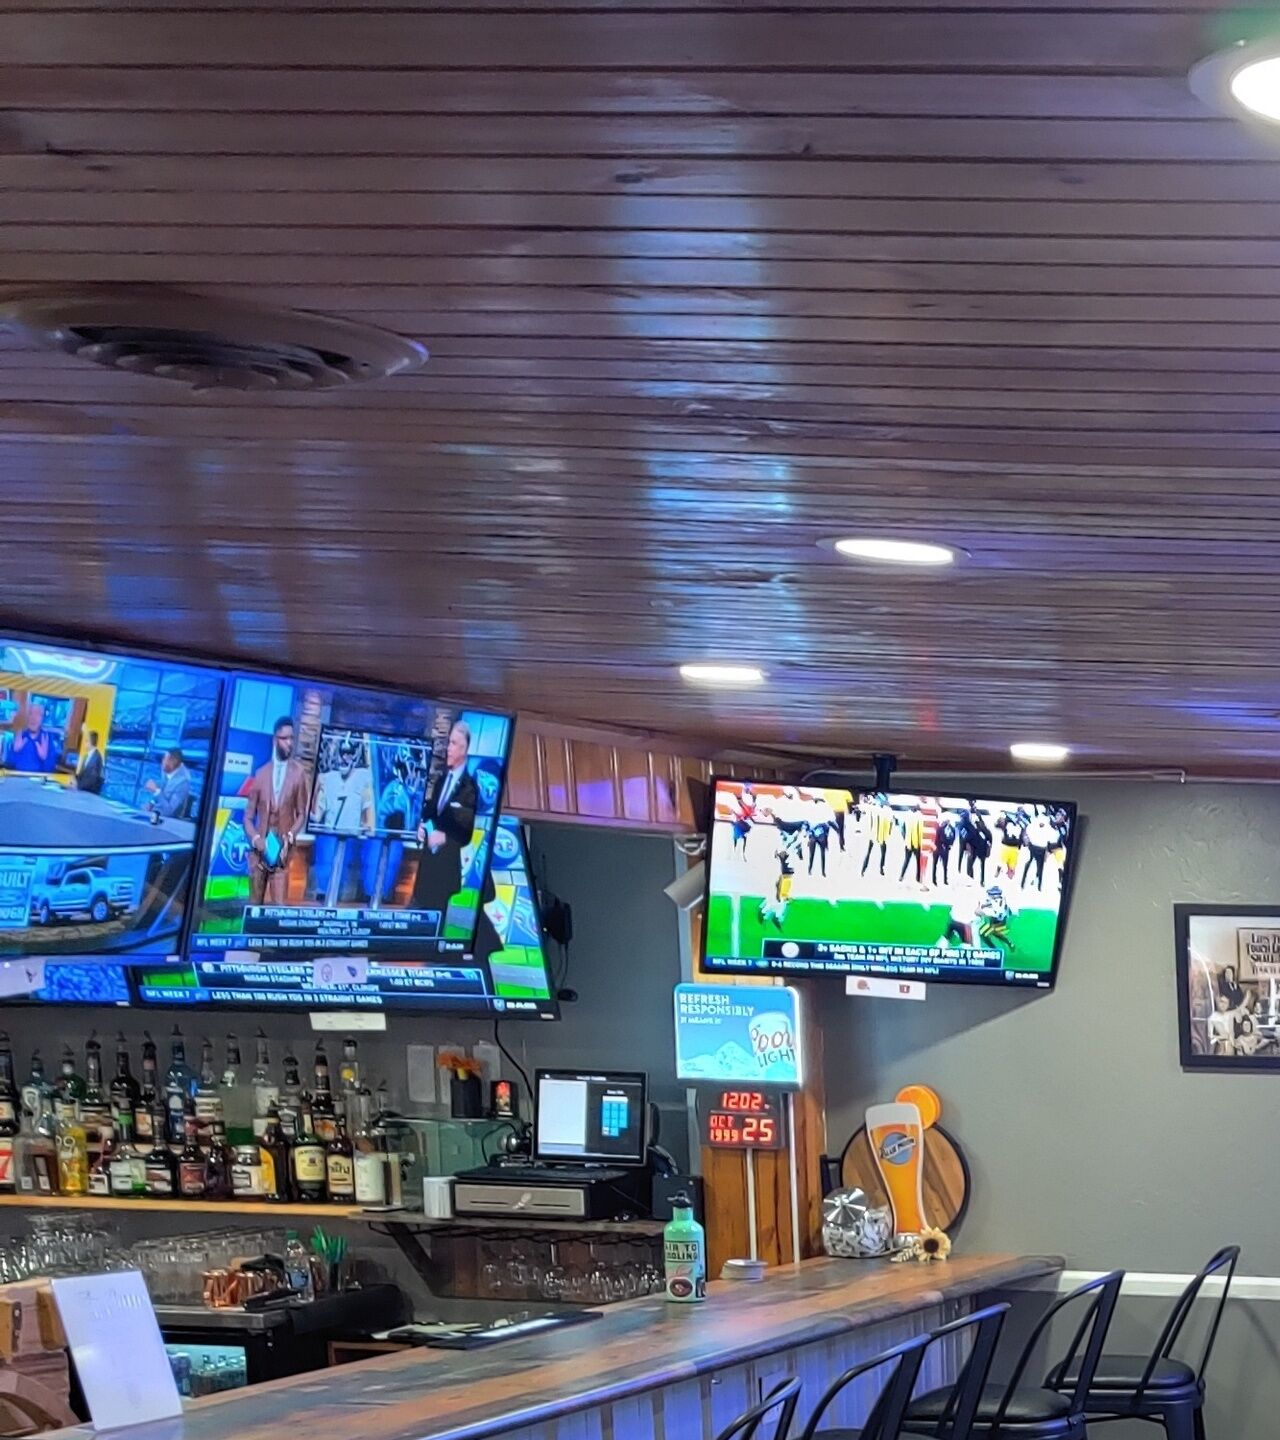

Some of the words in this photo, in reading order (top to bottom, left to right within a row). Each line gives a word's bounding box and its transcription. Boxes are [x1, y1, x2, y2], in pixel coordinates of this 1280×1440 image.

[679, 992, 730, 1004] REFRESH
[680, 1004, 755, 1017] RESPONSIBLY
[742, 1118, 774, 1142] 25
